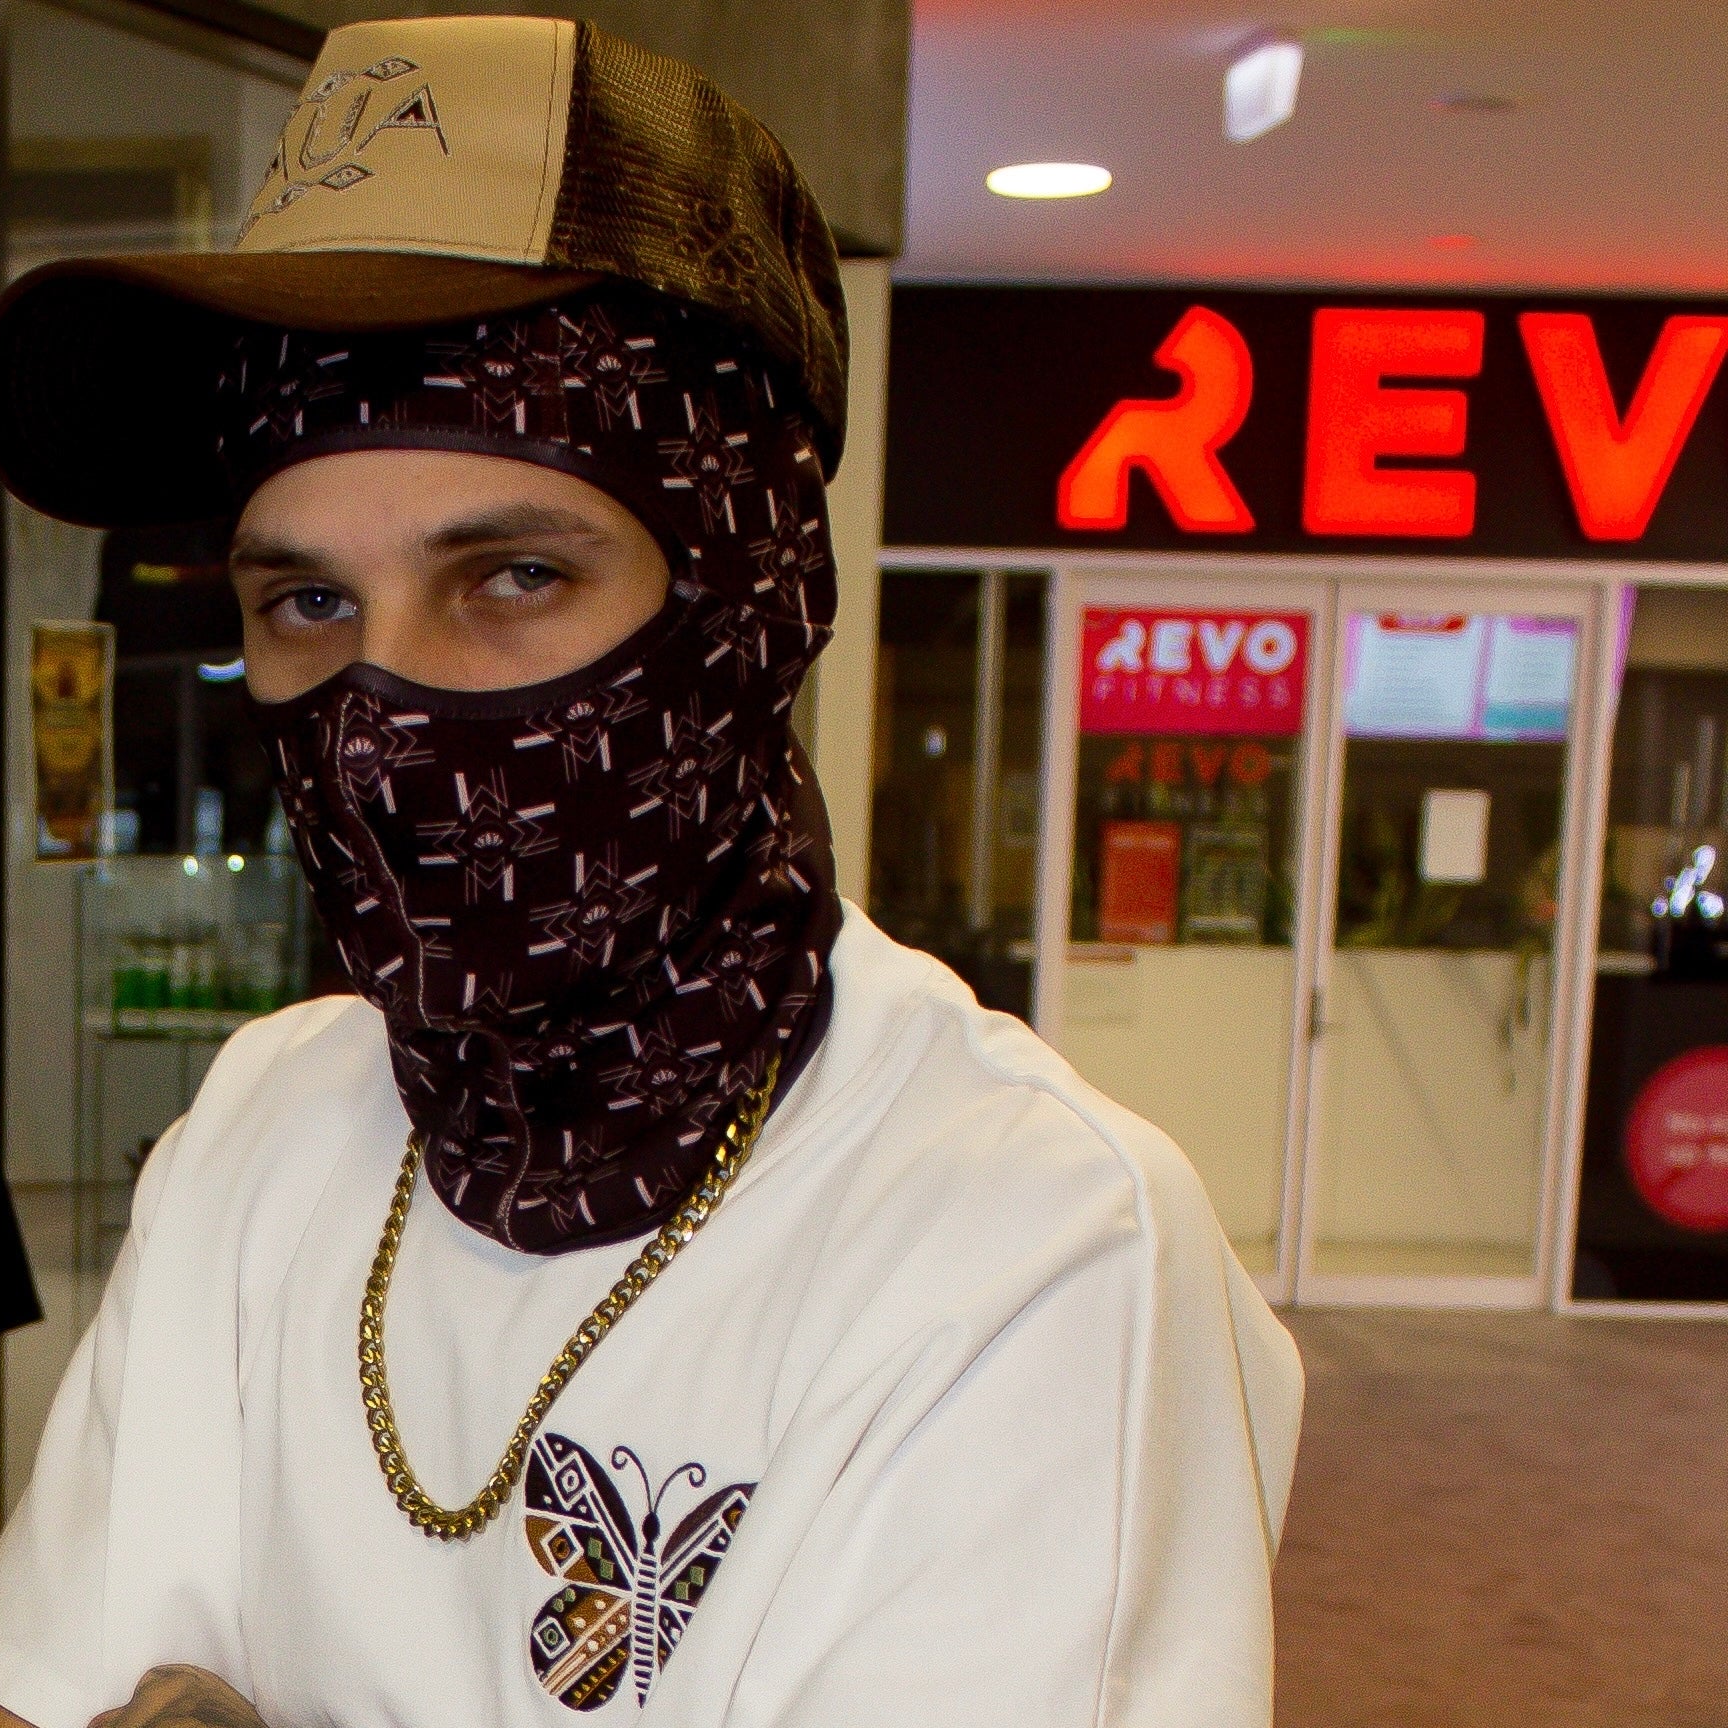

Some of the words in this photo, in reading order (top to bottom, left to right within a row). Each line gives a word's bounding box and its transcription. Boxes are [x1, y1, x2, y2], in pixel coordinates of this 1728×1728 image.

[1095, 619, 1299, 675] REVO
[1092, 677, 1292, 710] FITNESS
[1105, 743, 1273, 786] REVO
